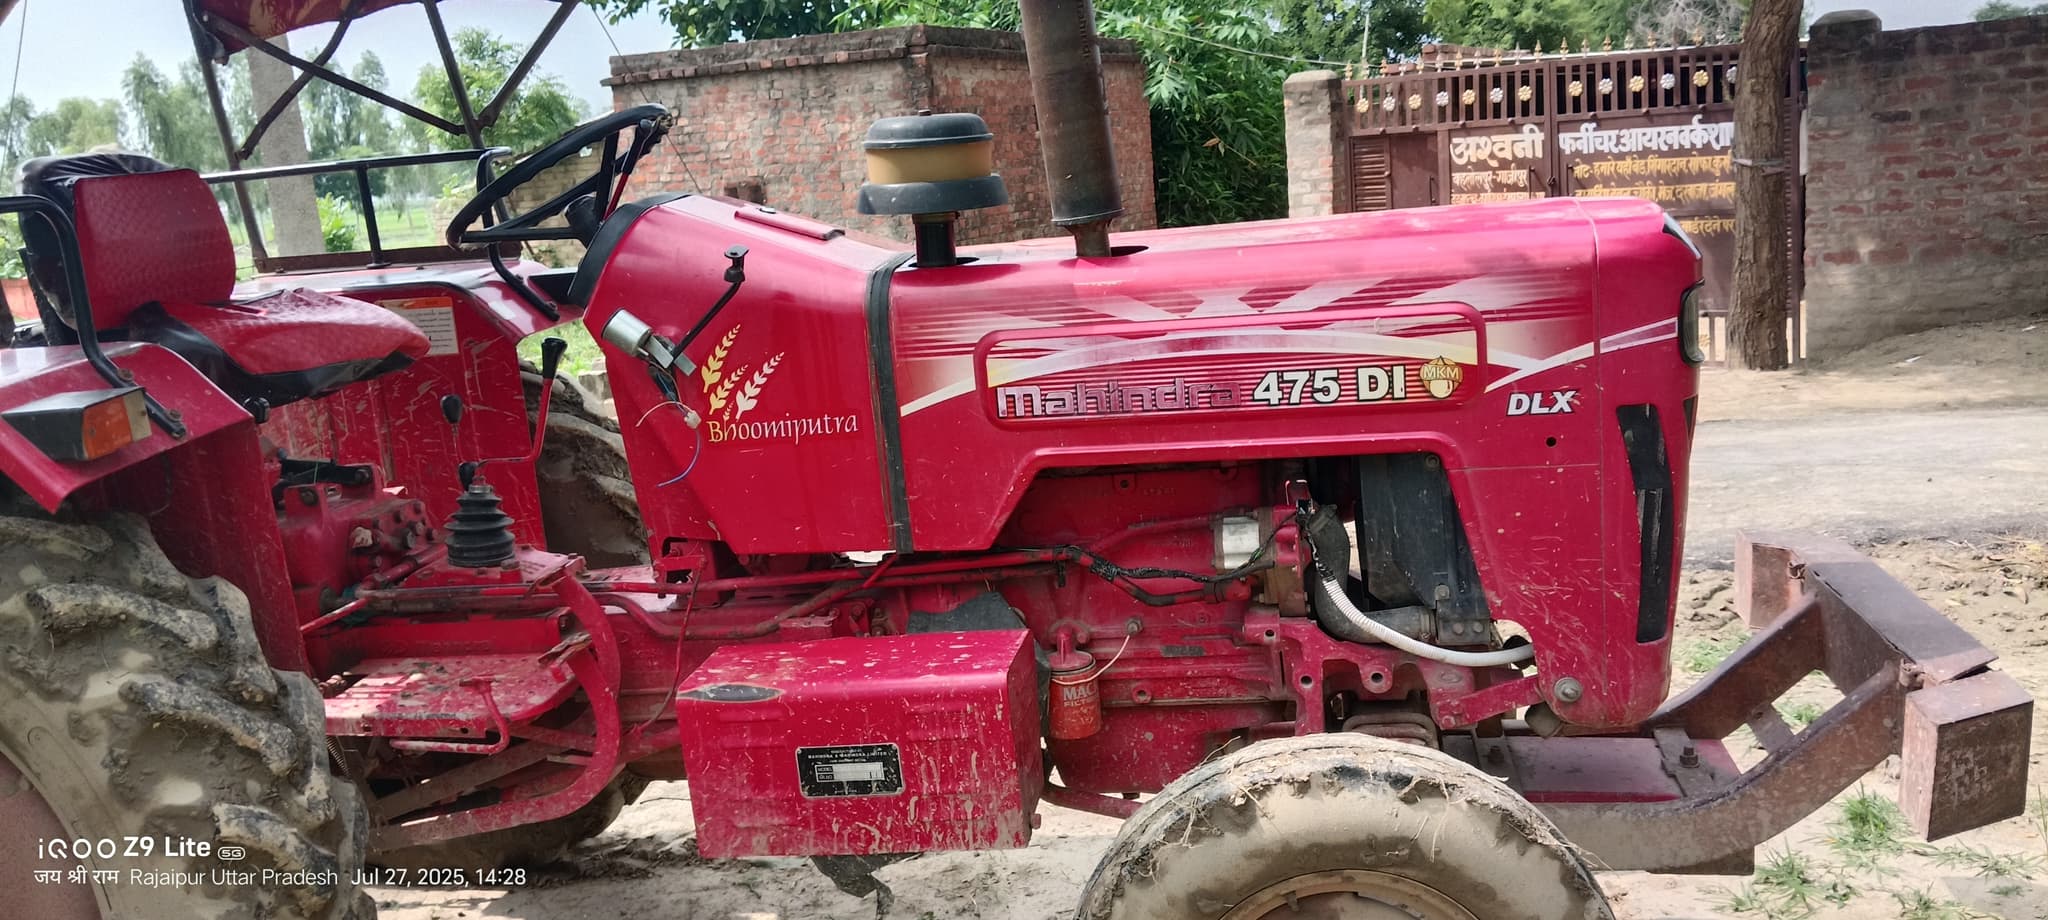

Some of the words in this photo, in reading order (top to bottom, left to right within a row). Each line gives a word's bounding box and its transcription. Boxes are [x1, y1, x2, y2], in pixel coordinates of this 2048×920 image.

[1450, 123, 1545, 167] अश्वनी
[1680, 114, 1736, 150] वर्कशा
[1252, 368, 1341, 407] 475
[1356, 364, 1407, 401] DI
[1422, 364, 1460, 380] MKM
[1506, 390, 1577, 416] DLX
[706, 412, 859, 446] Bhoomiputra
